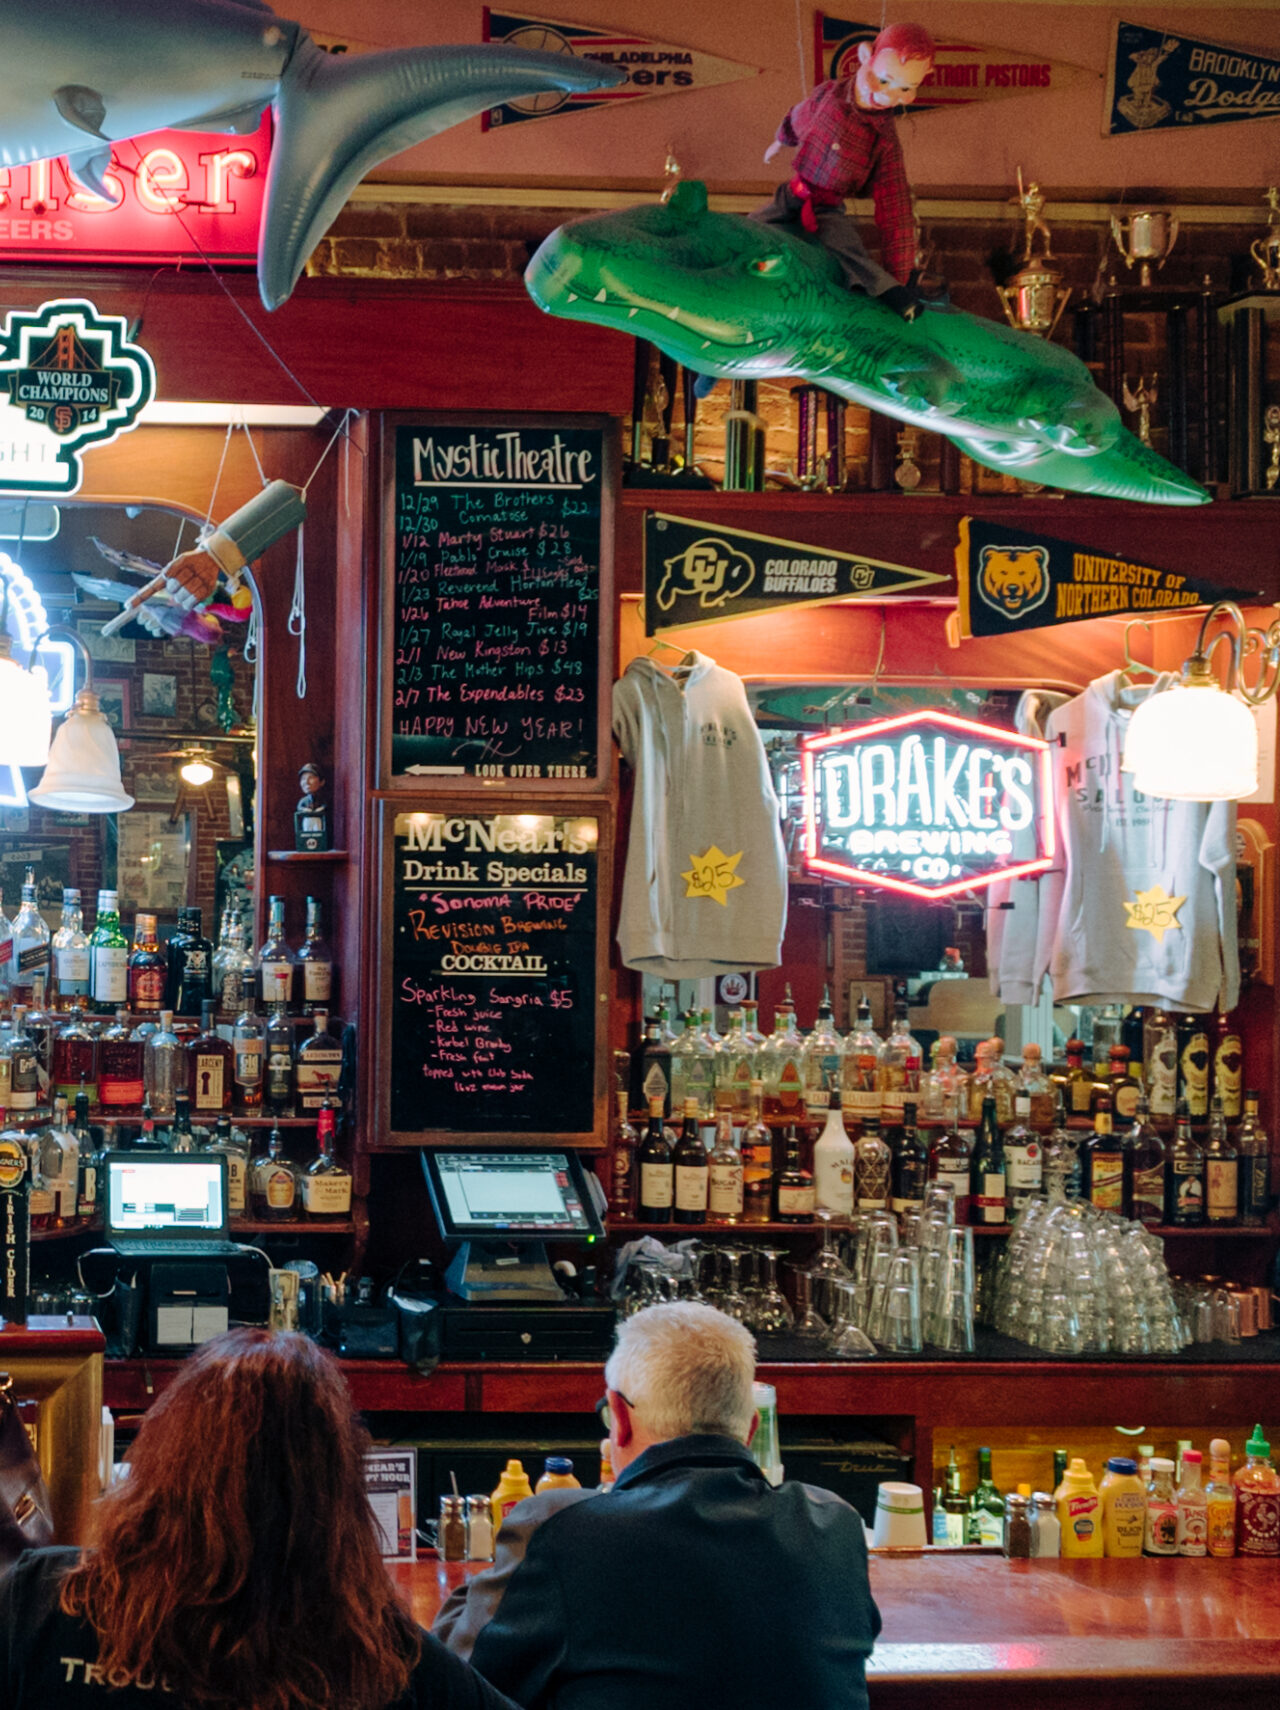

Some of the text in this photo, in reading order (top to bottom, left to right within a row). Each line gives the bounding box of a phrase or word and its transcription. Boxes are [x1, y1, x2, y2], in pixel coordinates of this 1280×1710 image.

[583, 52, 694, 64] PHILADELPHIA
[1188, 48, 1280, 82] BROOKLYN
[985, 64, 1052, 88] PISTONS
[37, 371, 92, 387] WORLD
[19, 384, 109, 403] CHAMPIONS
[29, 406, 97, 422] 20 14
[413, 432, 597, 483] Mystic Theatre
[401, 491, 591, 518] 12/29 The Brothers $22
[399, 511, 529, 534] 12/30 Comatose
[438, 532, 483, 551] Marty
[489, 526, 536, 543] Stuart
[538, 521, 570, 540] $26
[441, 550, 478, 564] Pablo
[488, 545, 530, 559] Cruise
[398, 568, 430, 585] 1/20
[764, 559, 839, 576] COLORADO
[1073, 552, 1187, 589] UNIVERSITY OF
[437, 580, 500, 596] Reverend
[763, 576, 838, 593] BUFFALOES
[1055, 582, 1200, 618] NORTHERN COLORADO
[528, 608, 559, 622] Film
[560, 603, 588, 622] $14
[400, 626, 431, 646] 1/27
[484, 624, 519, 644] Jelly
[526, 622, 558, 637] Jive
[561, 621, 588, 638] $19
[396, 638, 568, 665] 2/1 New Kingston $13
[397, 667, 423, 685] 2/3
[432, 664, 457, 680] The
[465, 662, 505, 678] Mother
[515, 662, 545, 679] Hips
[395, 683, 585, 709] 2/7 The Expendables $23
[400, 716, 455, 738] HAPPY
[465, 715, 509, 736] NEW
[475, 764, 588, 778] LOOK OVER THERE
[822, 734, 1034, 831] DRAKE'S
[848, 830, 1012, 856] BREWING
[402, 859, 588, 888] Drink Specials
[692, 860, 738, 892] $25
[1130, 901, 1172, 930] $25
[440, 954, 548, 972] COCKTAIL
[400, 977, 574, 1010] Sparkling Sangria $5
[472, 1008, 504, 1022] juice
[463, 1022, 492, 1034] wine
[6, 1193, 17, 1298] IRISH CIDER
